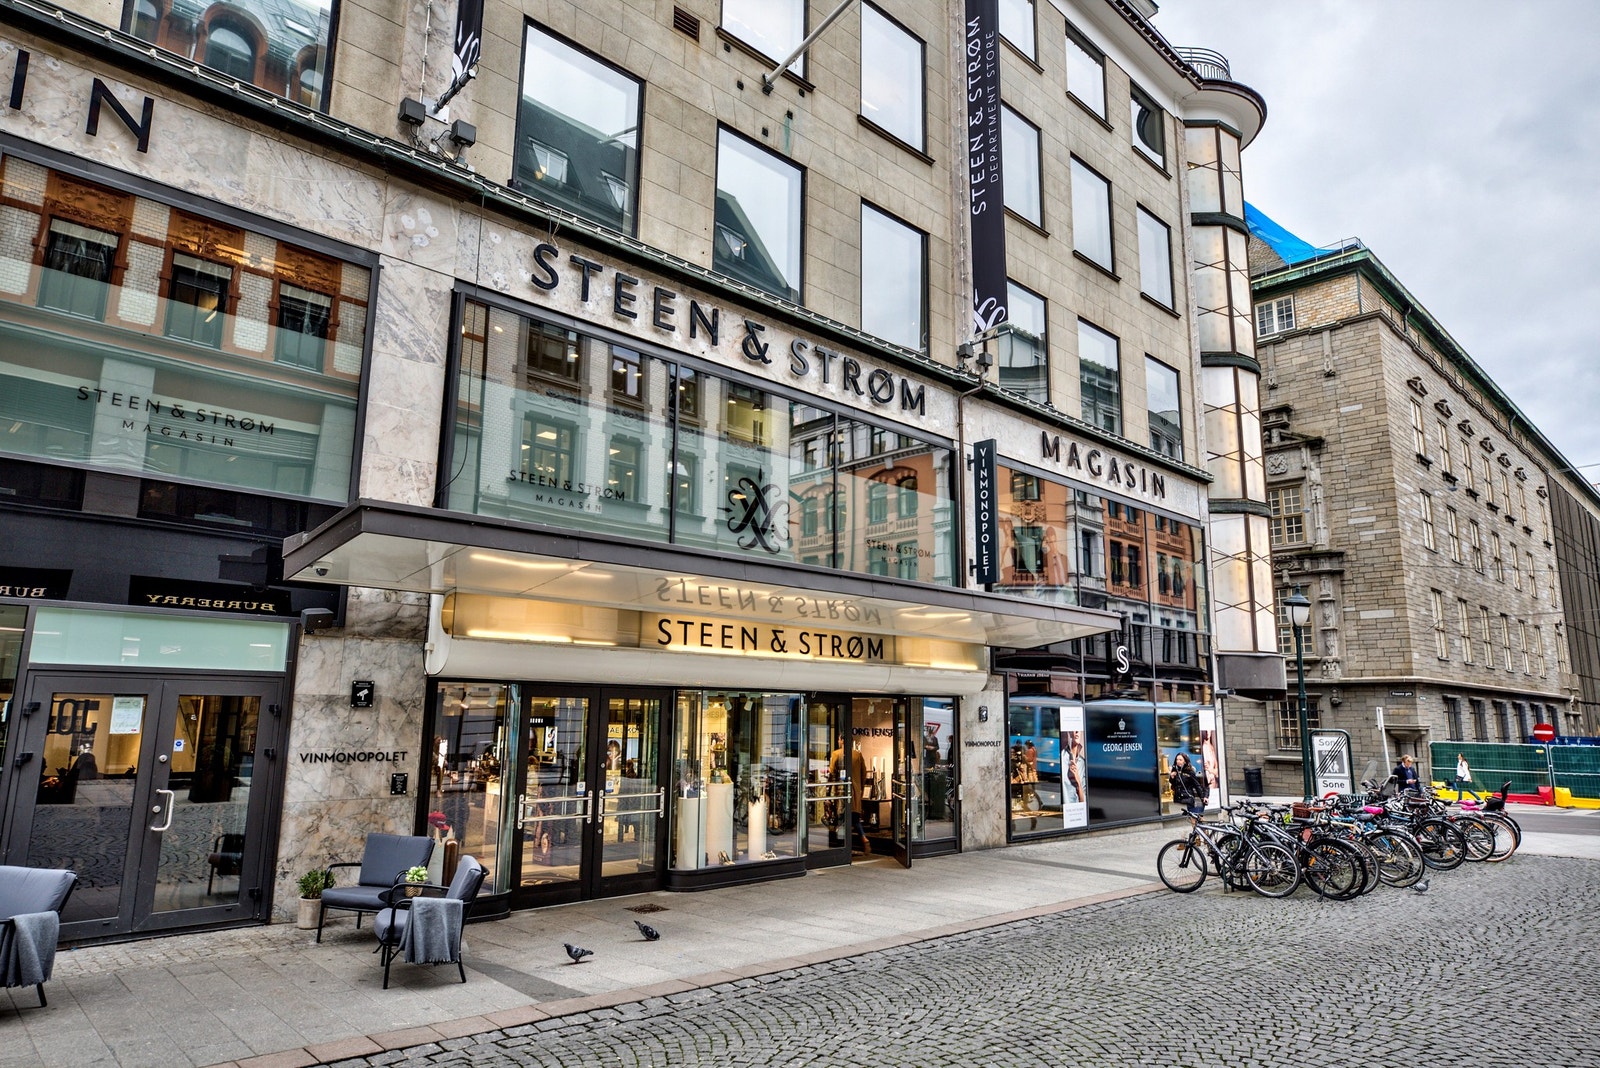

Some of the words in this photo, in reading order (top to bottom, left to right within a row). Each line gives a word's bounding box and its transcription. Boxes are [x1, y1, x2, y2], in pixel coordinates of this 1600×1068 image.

[967, 16, 983, 106] STRØM
[986, 30, 995, 78] STORE
[970, 111, 984, 126] &
[987, 86, 999, 183] DEPARTMENT
[972, 133, 987, 216] STEEN
[531, 243, 719, 346] STEEN
[742, 319, 772, 365] &
[790, 338, 927, 417] STRØM
[77, 386, 160, 414] STEEN
[171, 404, 185, 419] &
[195, 409, 275, 435] STRØM
[122, 420, 234, 447] MAGASIN
[509, 470, 557, 489] STEEN
[563, 481, 572, 492] &
[577, 483, 625, 501] STRØM
[1041, 430, 1166, 499] MAGASIN
[536, 494, 601, 511] MAGASIN
[978, 447, 990, 576] VINMONOPOLET
[657, 619, 757, 650] STEEN
[770, 629, 788, 654] &
[799, 631, 884, 660] STRØM
[300, 751, 408, 763] VINMONOPOLET
[1102, 743, 1122, 752] GEORG
[1123, 743, 1143, 753] JENSEN
[1322, 780, 1345, 788] Sone
